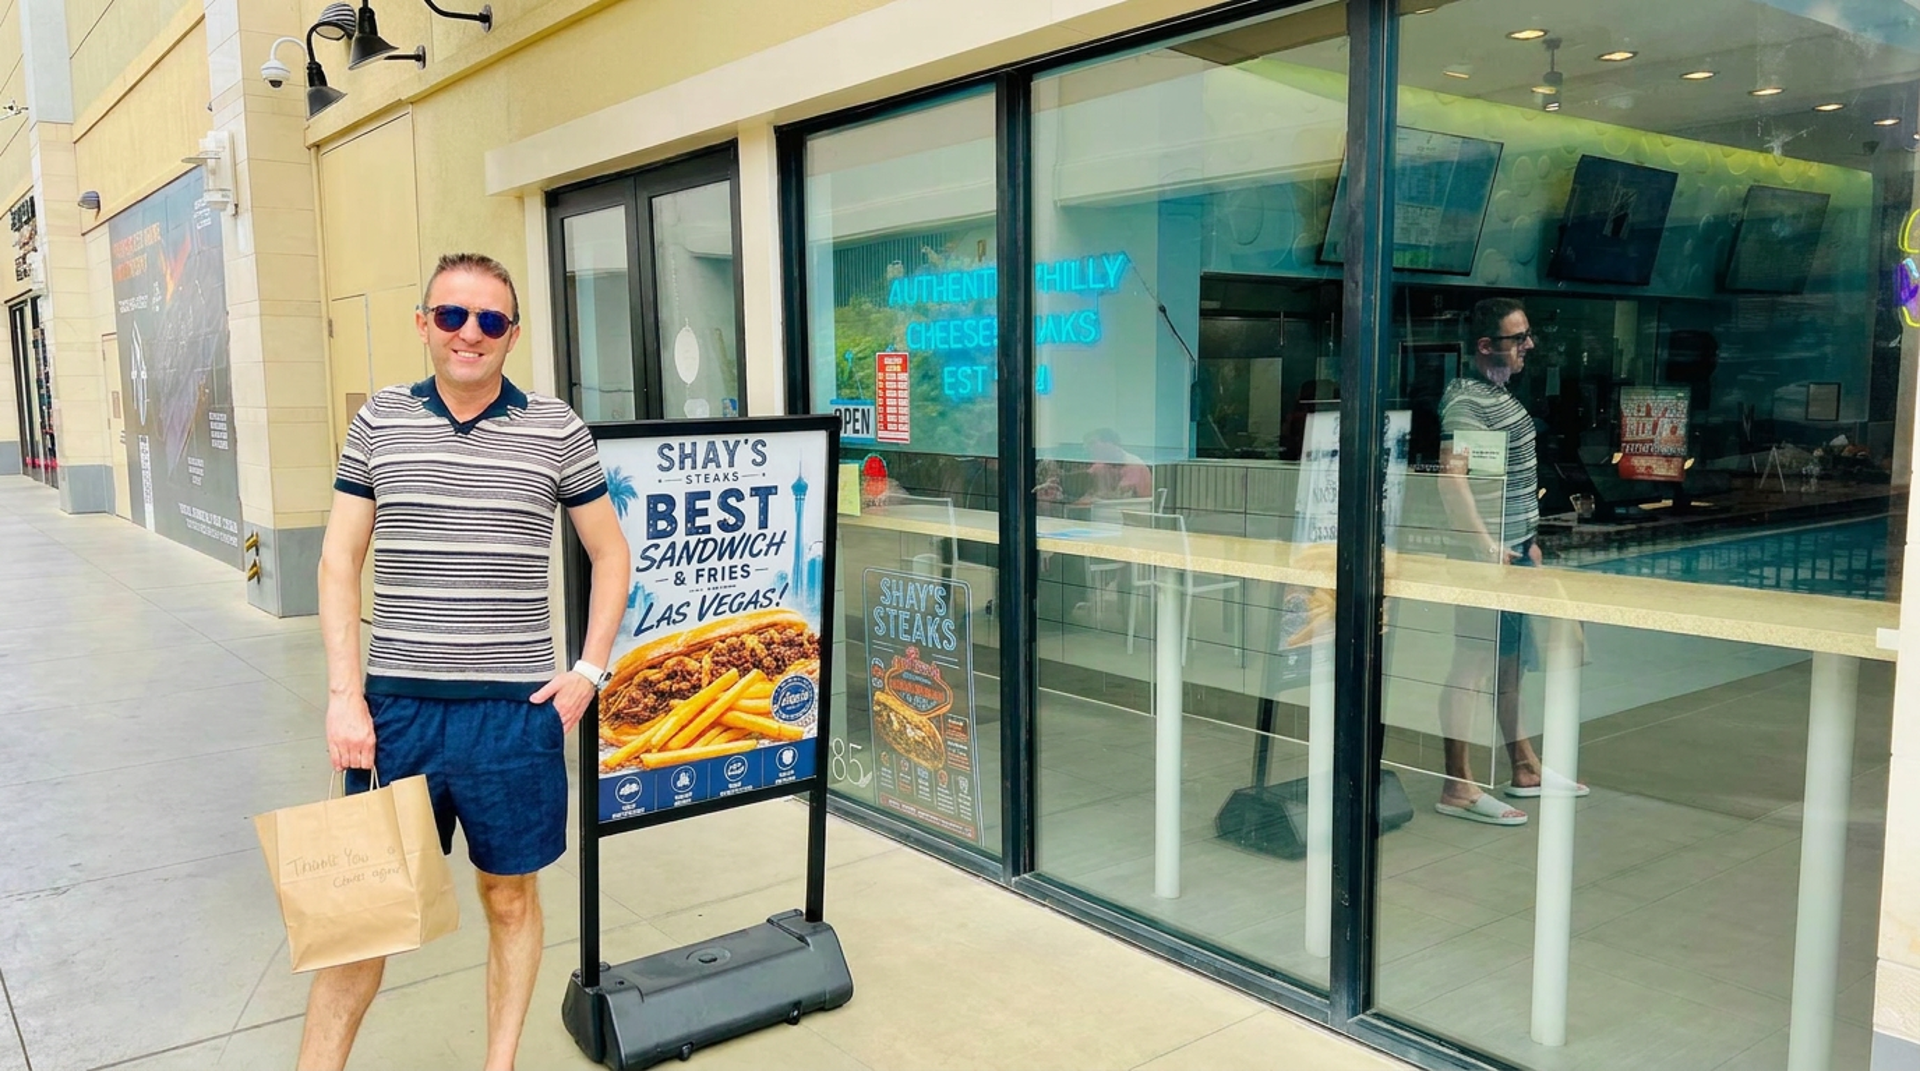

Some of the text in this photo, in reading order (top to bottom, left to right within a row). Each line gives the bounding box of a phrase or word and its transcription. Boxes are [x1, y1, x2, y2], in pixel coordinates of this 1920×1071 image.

[943, 366, 988, 395] EST
[657, 438, 768, 472] SHAY'S
[646, 485, 778, 540] BEST
[635, 530, 787, 573] SANDWICH
[673, 563, 751, 586] & FRIES
[697, 582, 789, 622] VEGAS!
[879, 576, 947, 616] SHAY'S
[872, 606, 957, 651] STEAKS
